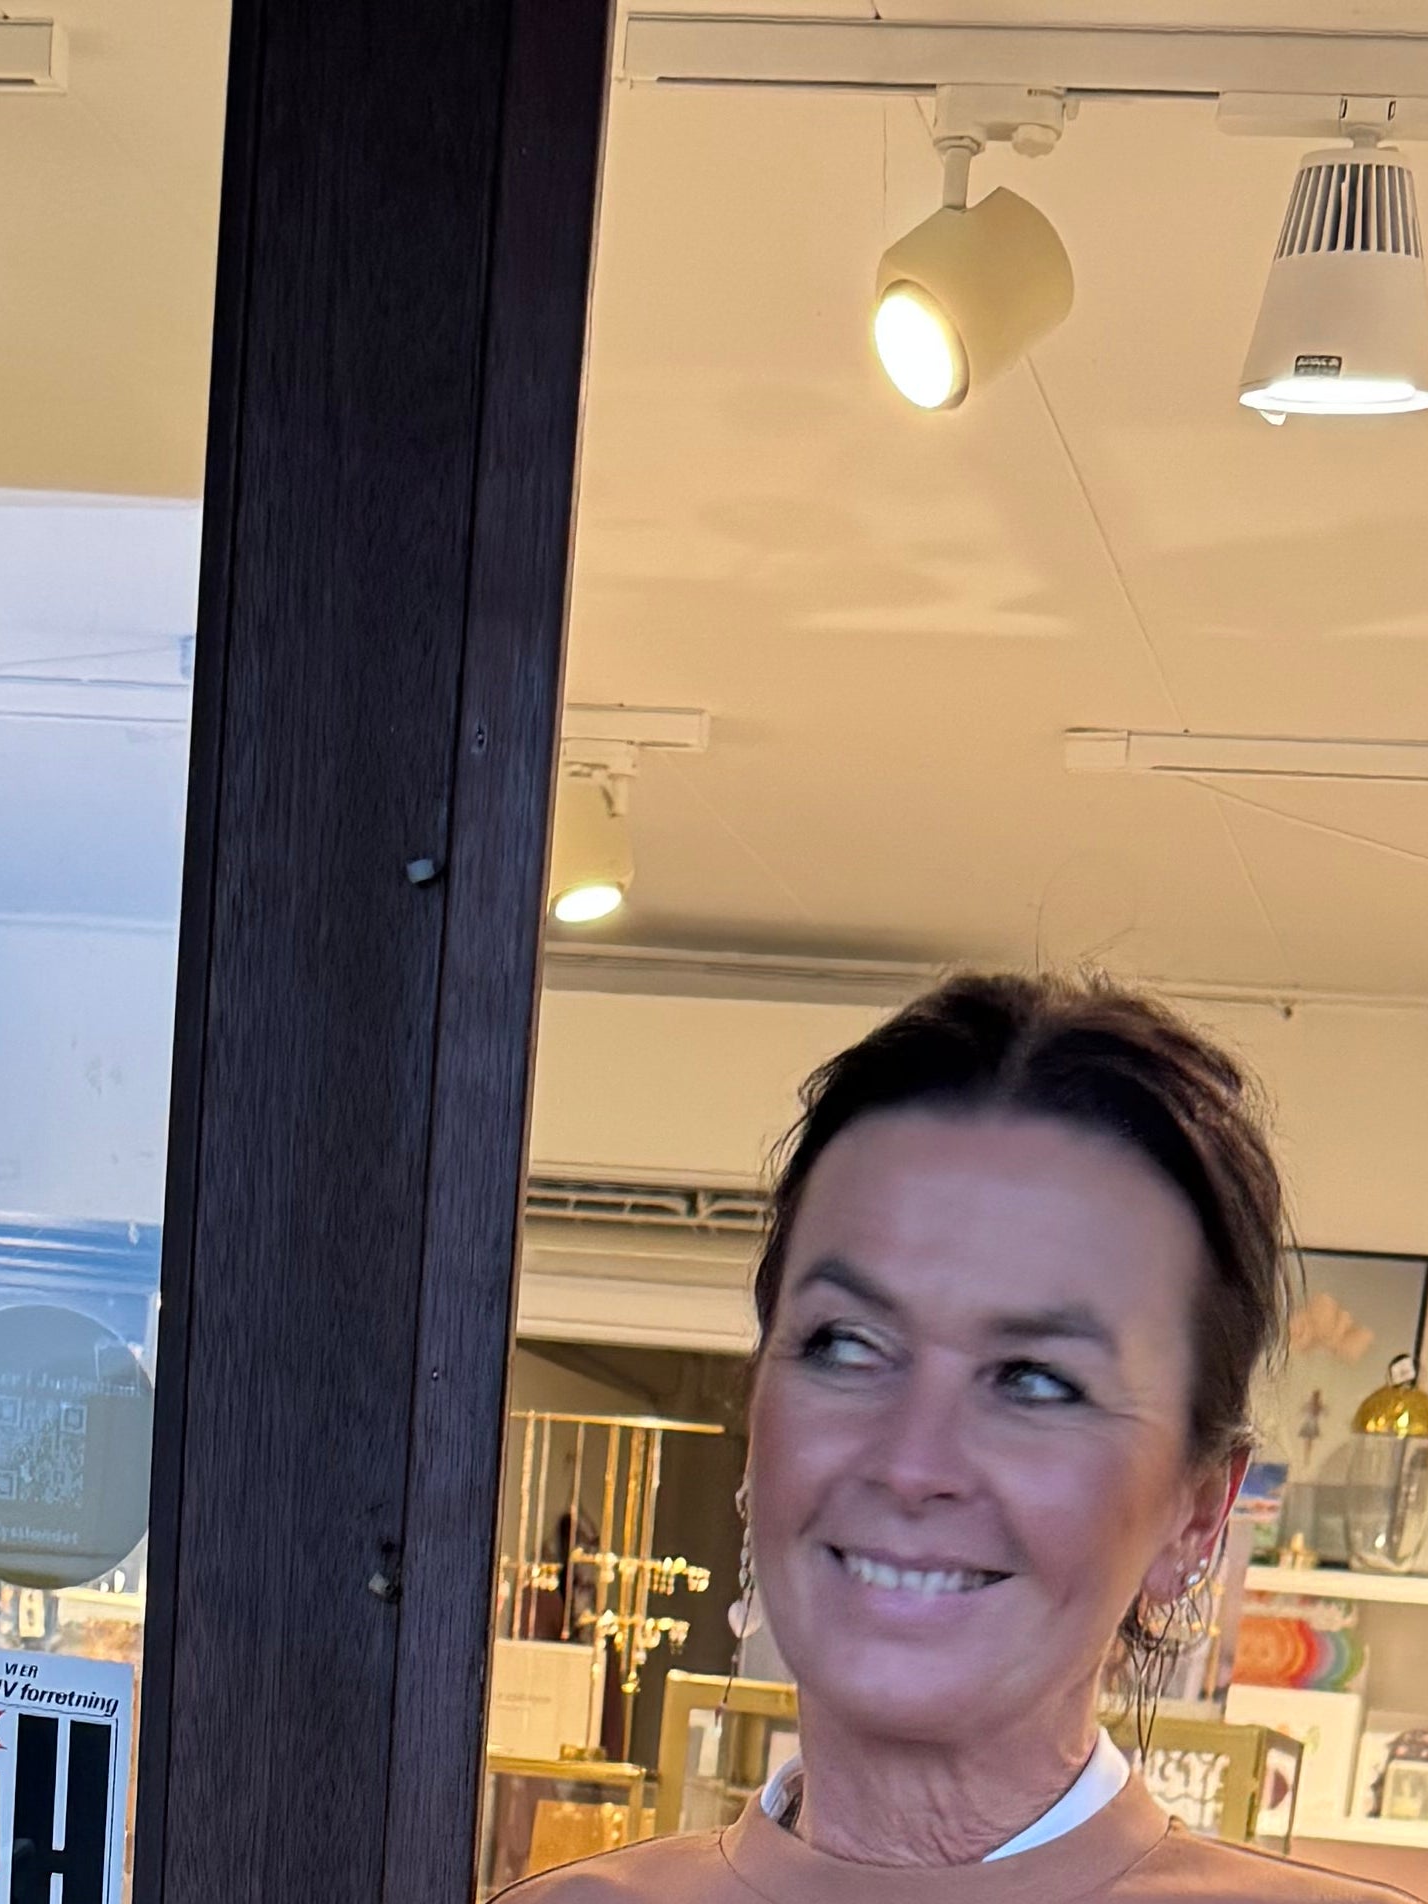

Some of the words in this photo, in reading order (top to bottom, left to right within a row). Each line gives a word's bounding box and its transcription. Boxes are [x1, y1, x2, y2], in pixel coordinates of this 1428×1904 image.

[4, 1662, 17, 1676] VI
[20, 1663, 39, 1679] ER
[19, 1683, 119, 1717] forretning
